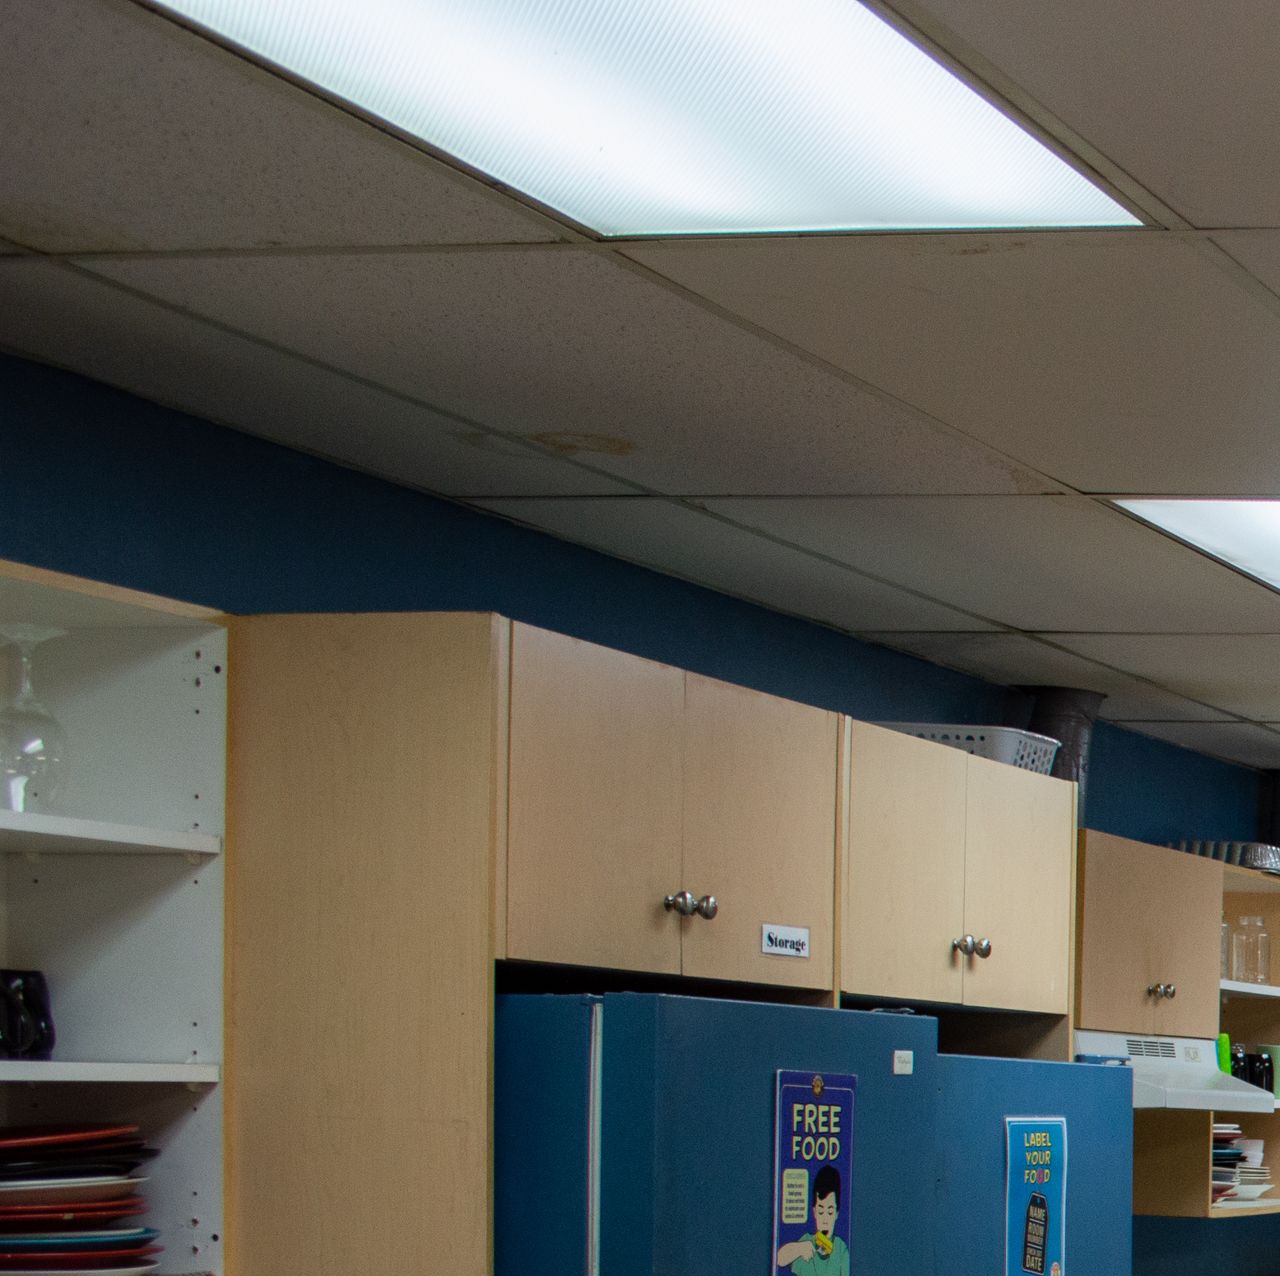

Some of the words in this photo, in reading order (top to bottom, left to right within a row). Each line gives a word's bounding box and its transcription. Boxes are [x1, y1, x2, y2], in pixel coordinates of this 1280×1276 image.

[767, 931, 806, 954] Storage
[793, 1103, 842, 1134] FREE
[792, 1135, 841, 1161] FOOD
[1024, 1132, 1051, 1147] LABEL
[1025, 1151, 1051, 1166] YOUR
[1025, 1254, 1042, 1271] DATE
